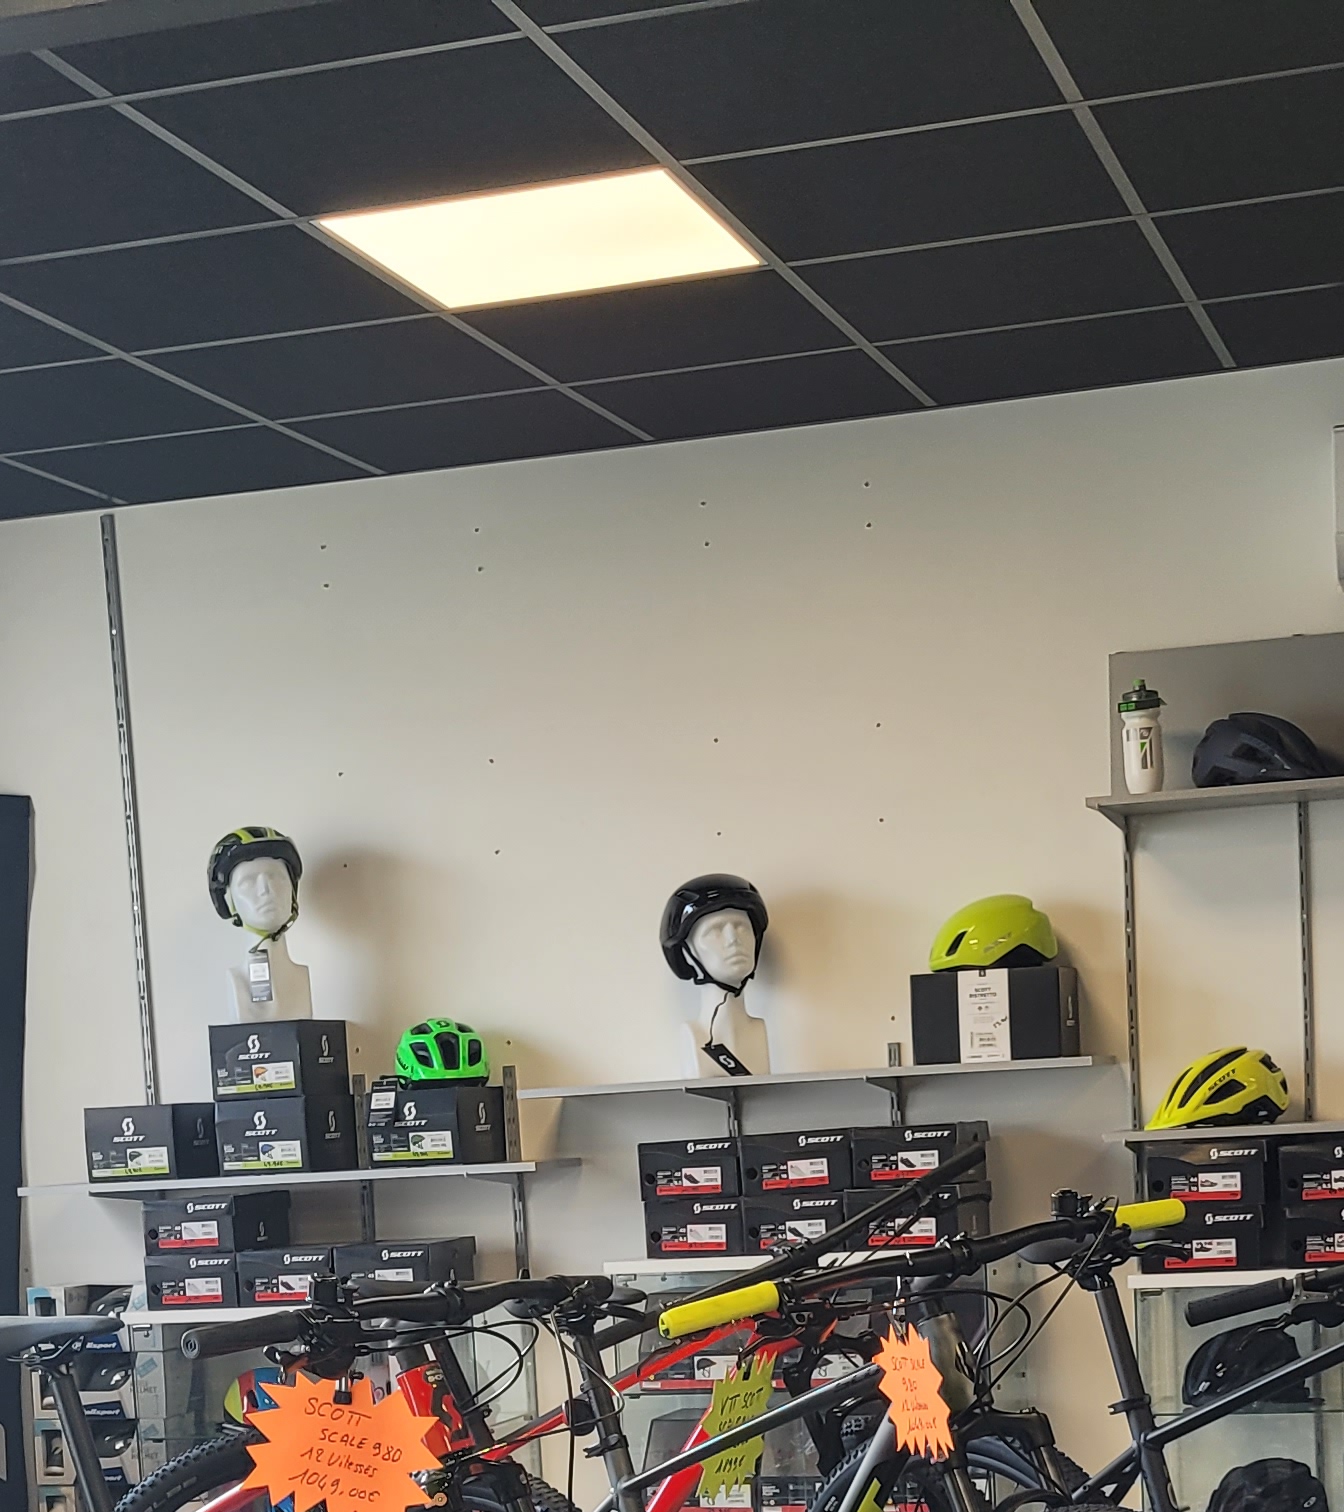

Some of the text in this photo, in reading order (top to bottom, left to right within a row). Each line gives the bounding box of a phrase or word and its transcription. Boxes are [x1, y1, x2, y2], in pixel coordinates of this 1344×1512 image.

[237, 1051, 272, 1061] SCOTT
[1207, 1068, 1236, 1092] SCOTT
[393, 1119, 429, 1128] SCOTT
[244, 1128, 279, 1138] SCOTT
[912, 1130, 952, 1140] SCOTT
[112, 1134, 146, 1144] SCOTT
[805, 1135, 844, 1145] SCOTT
[694, 1141, 732, 1151] SCOTT
[1218, 1148, 1259, 1158] SCOTT
[194, 1202, 228, 1212] SCOTT
[701, 1203, 738, 1212] SCOTT
[801, 1199, 839, 1208] SCOTT
[1214, 1214, 1254, 1222] SCOTT
[290, 1254, 326, 1264] SCOTT
[388, 1250, 424, 1260] SCOTT
[197, 1258, 232, 1268] SCOTT
[304, 1397, 372, 1427] SCOTT
[318, 1428, 403, 1463] SCALE 980
